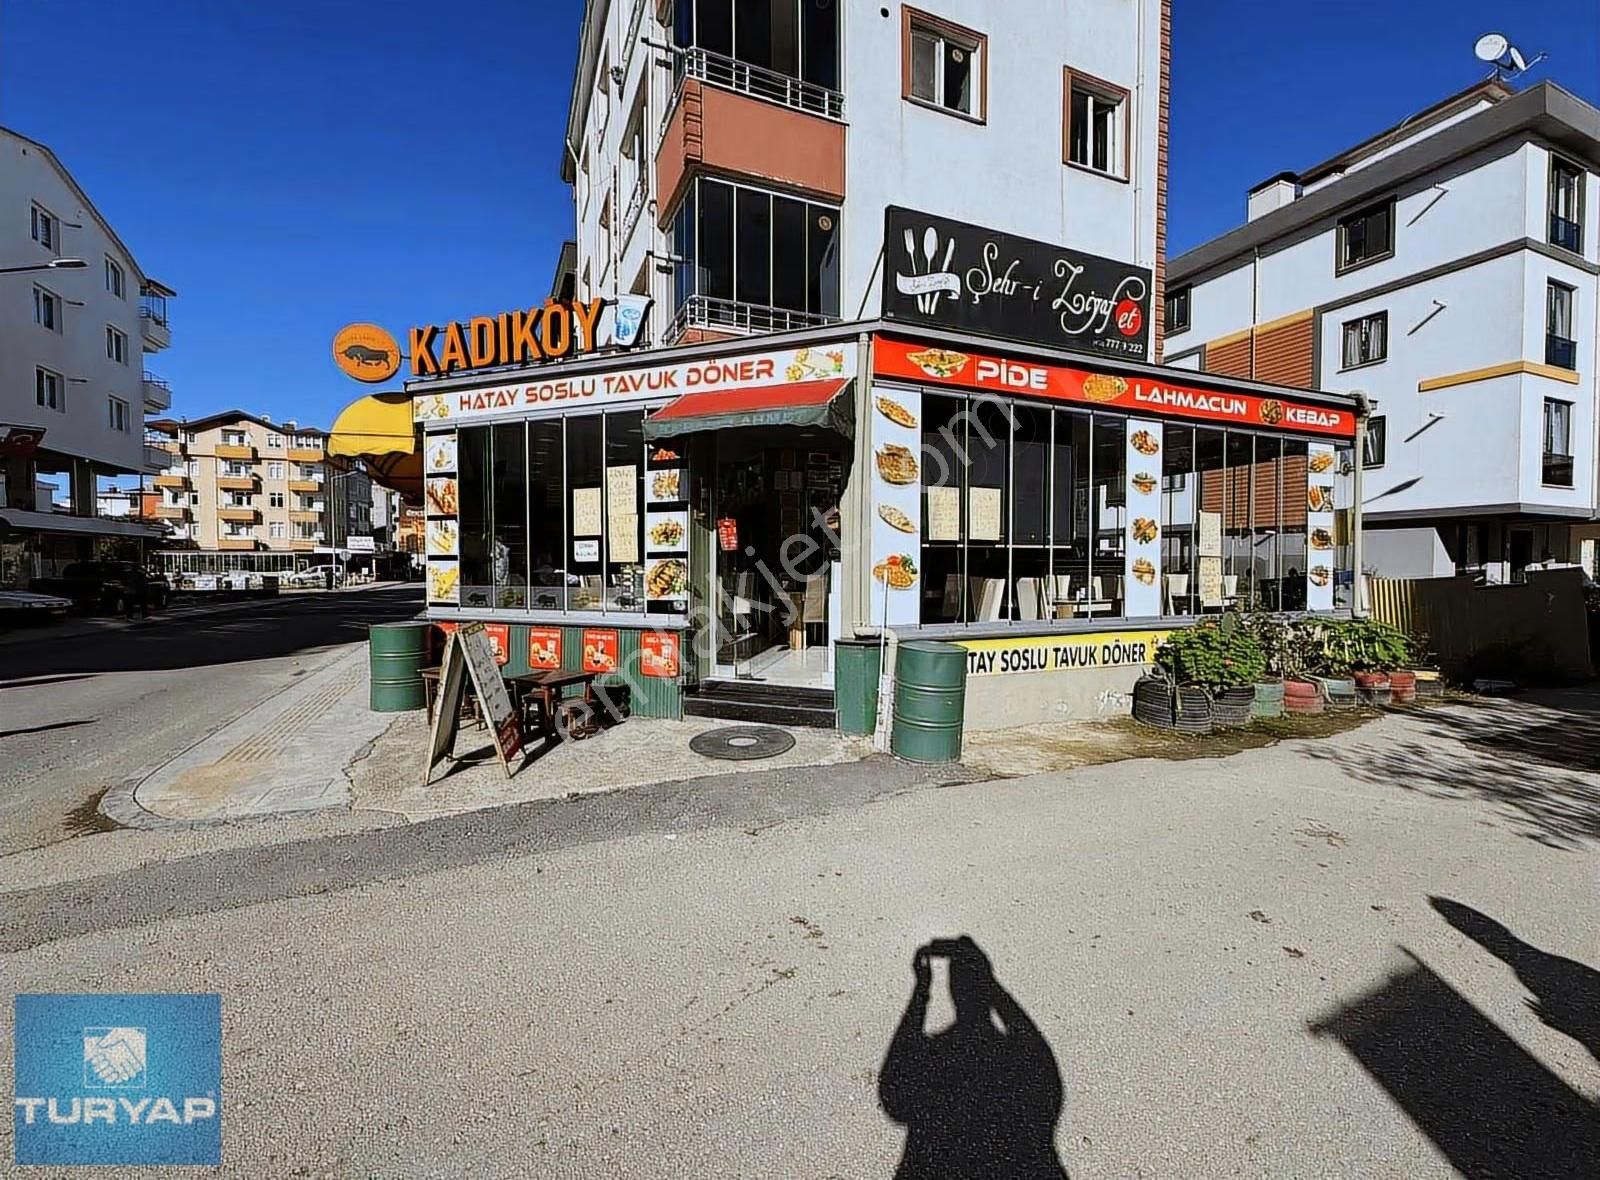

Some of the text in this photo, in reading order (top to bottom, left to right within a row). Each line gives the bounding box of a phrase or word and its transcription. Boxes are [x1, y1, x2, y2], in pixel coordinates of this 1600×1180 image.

[409, 297, 602, 375] KADIKÖY
[460, 358, 775, 412] HATAY SOSLU TAVUK DÖNER
[976, 358, 1049, 390] PİDE
[1135, 384, 1247, 415] LAHMACUN
[1286, 406, 1340, 427] KEBAP
[967, 639, 1146, 674] TAY SOSLU TAVUK DÖNER
